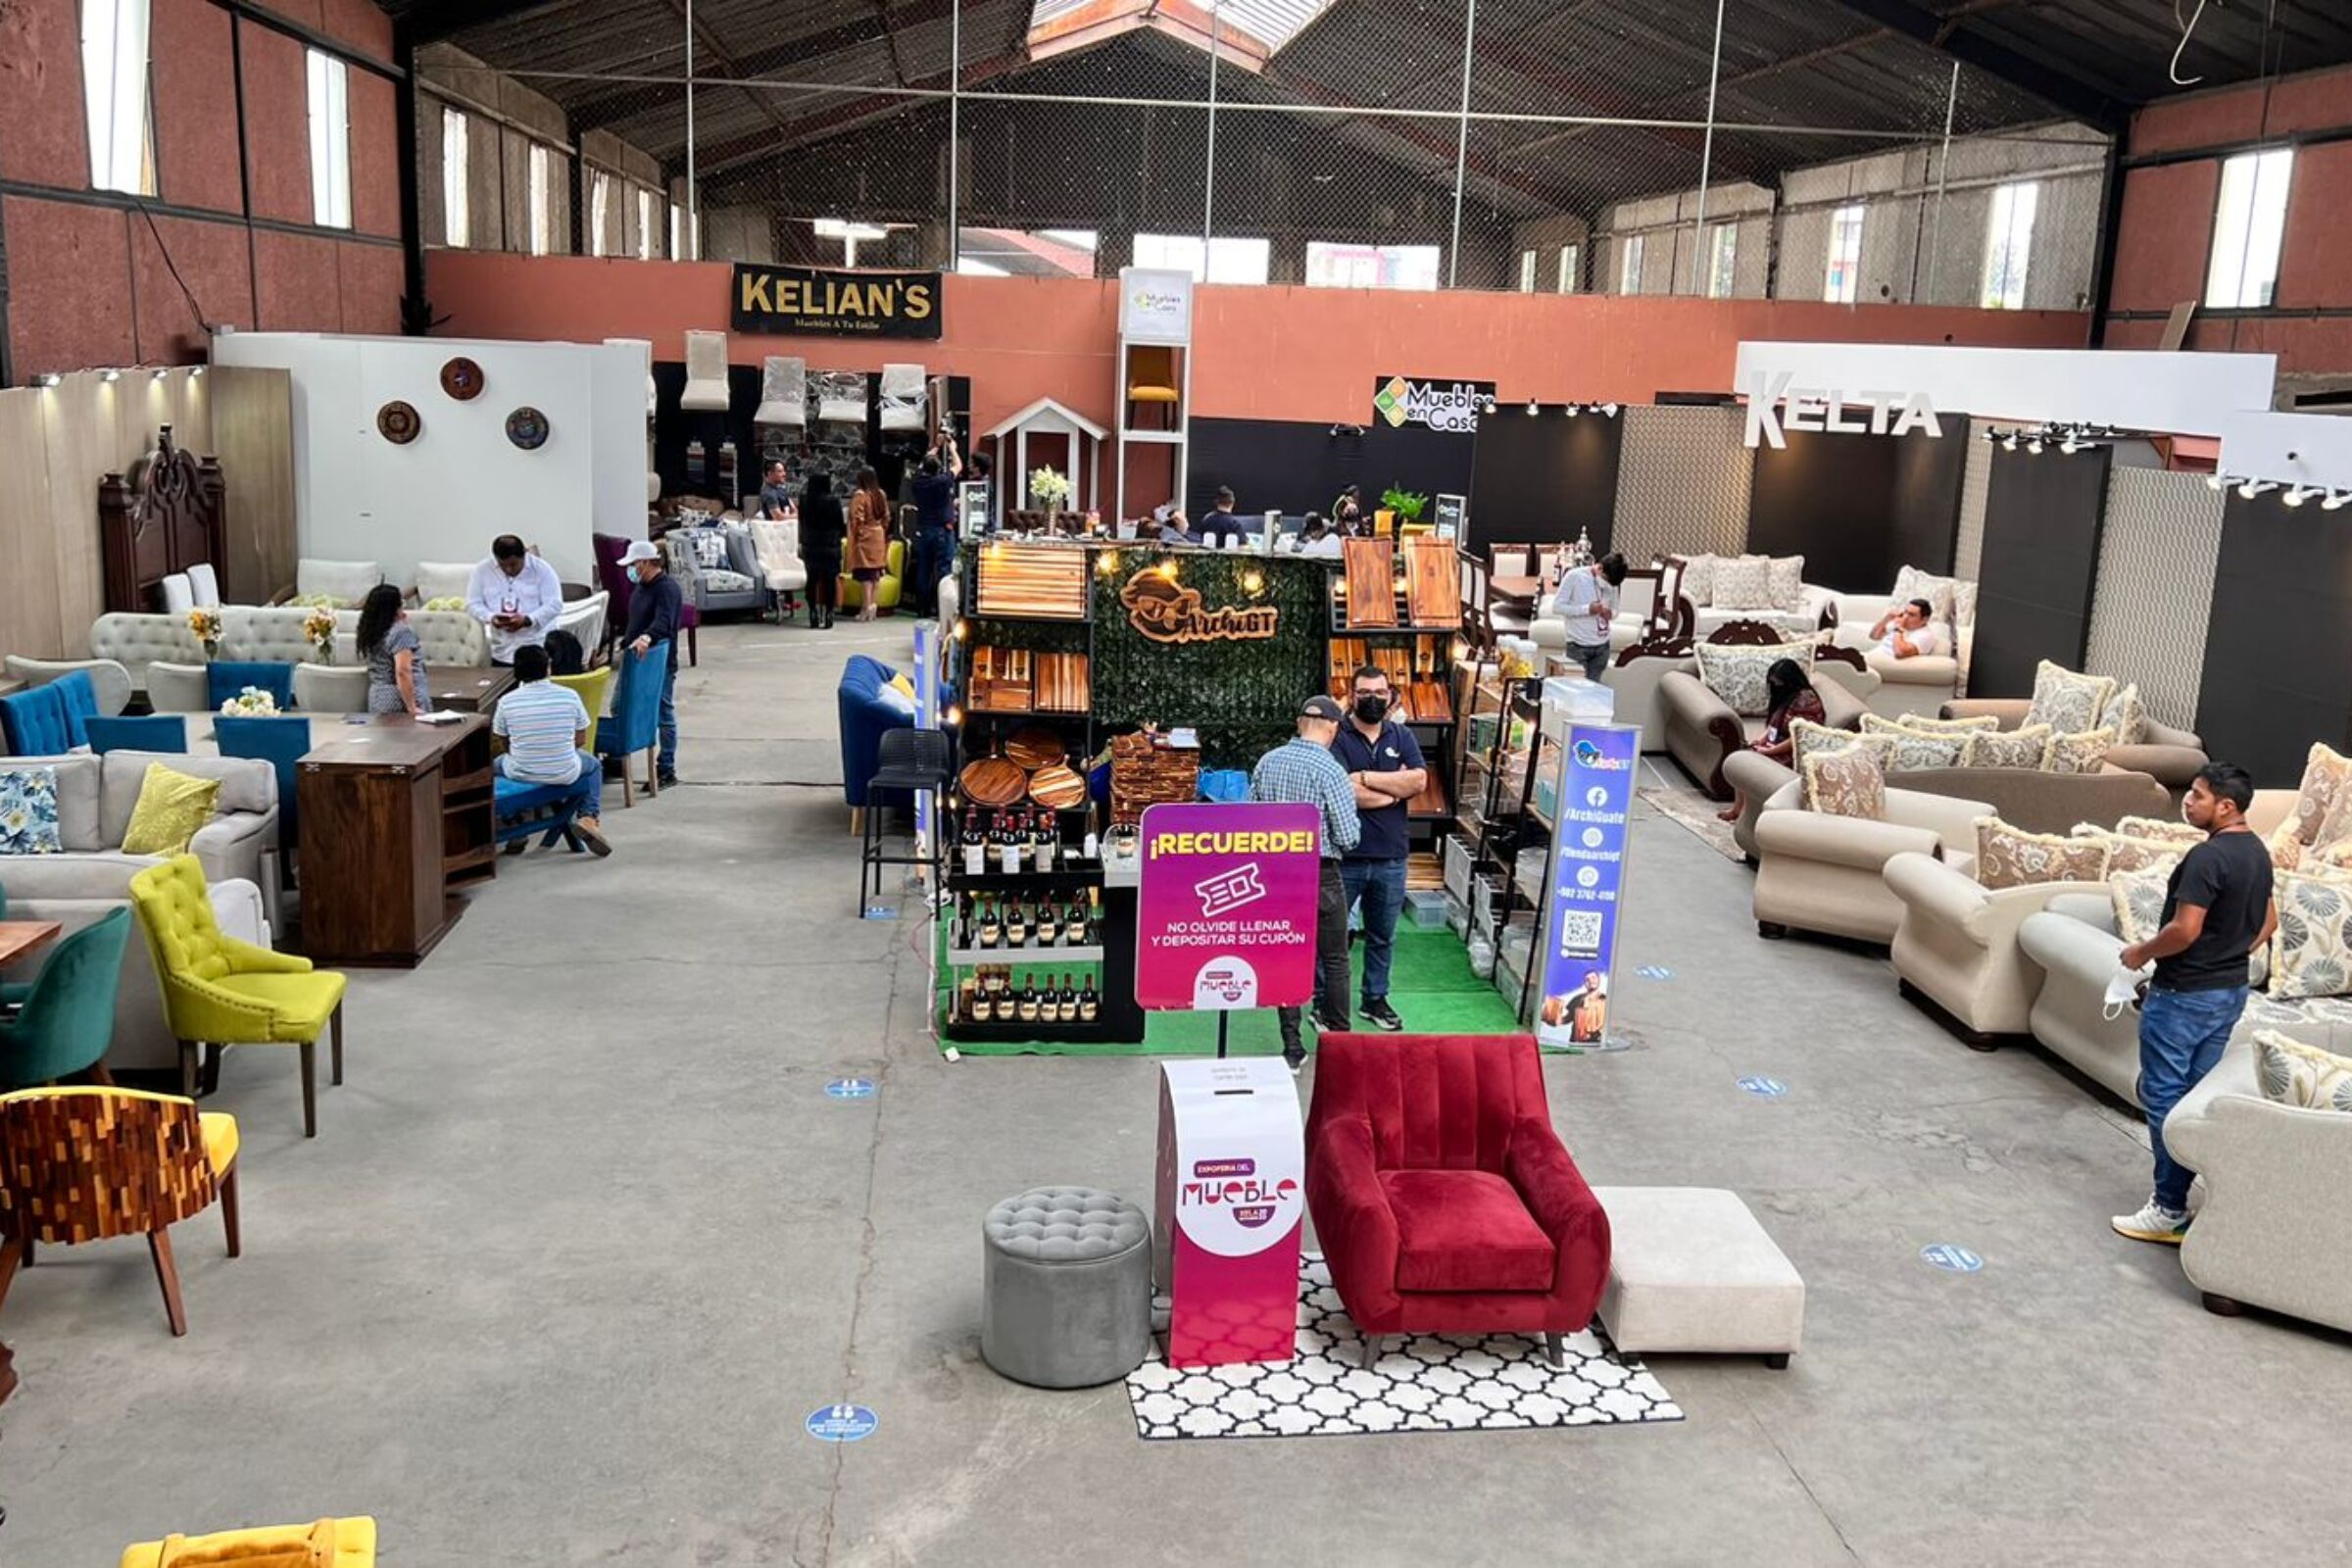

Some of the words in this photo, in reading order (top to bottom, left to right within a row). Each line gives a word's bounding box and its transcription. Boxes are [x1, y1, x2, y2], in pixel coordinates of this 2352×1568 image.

[741, 272, 931, 318] KELIAN'S
[1407, 408, 1427, 418] en
[1743, 369, 1943, 450] KELTA
[1150, 830, 1314, 860] ¡RECUERDE!
[1167, 922, 1188, 933] NO
[1190, 921, 1237, 932] OLVIDE
[1240, 920, 1291, 932] LLENAR
[1152, 936, 1159, 947] Y
[1162, 935, 1236, 947] DEPOSITAR
[1239, 934, 1256, 946] SU
[1259, 931, 1306, 946] CUPÓN
[1237, 1163, 1250, 1172] DEL
